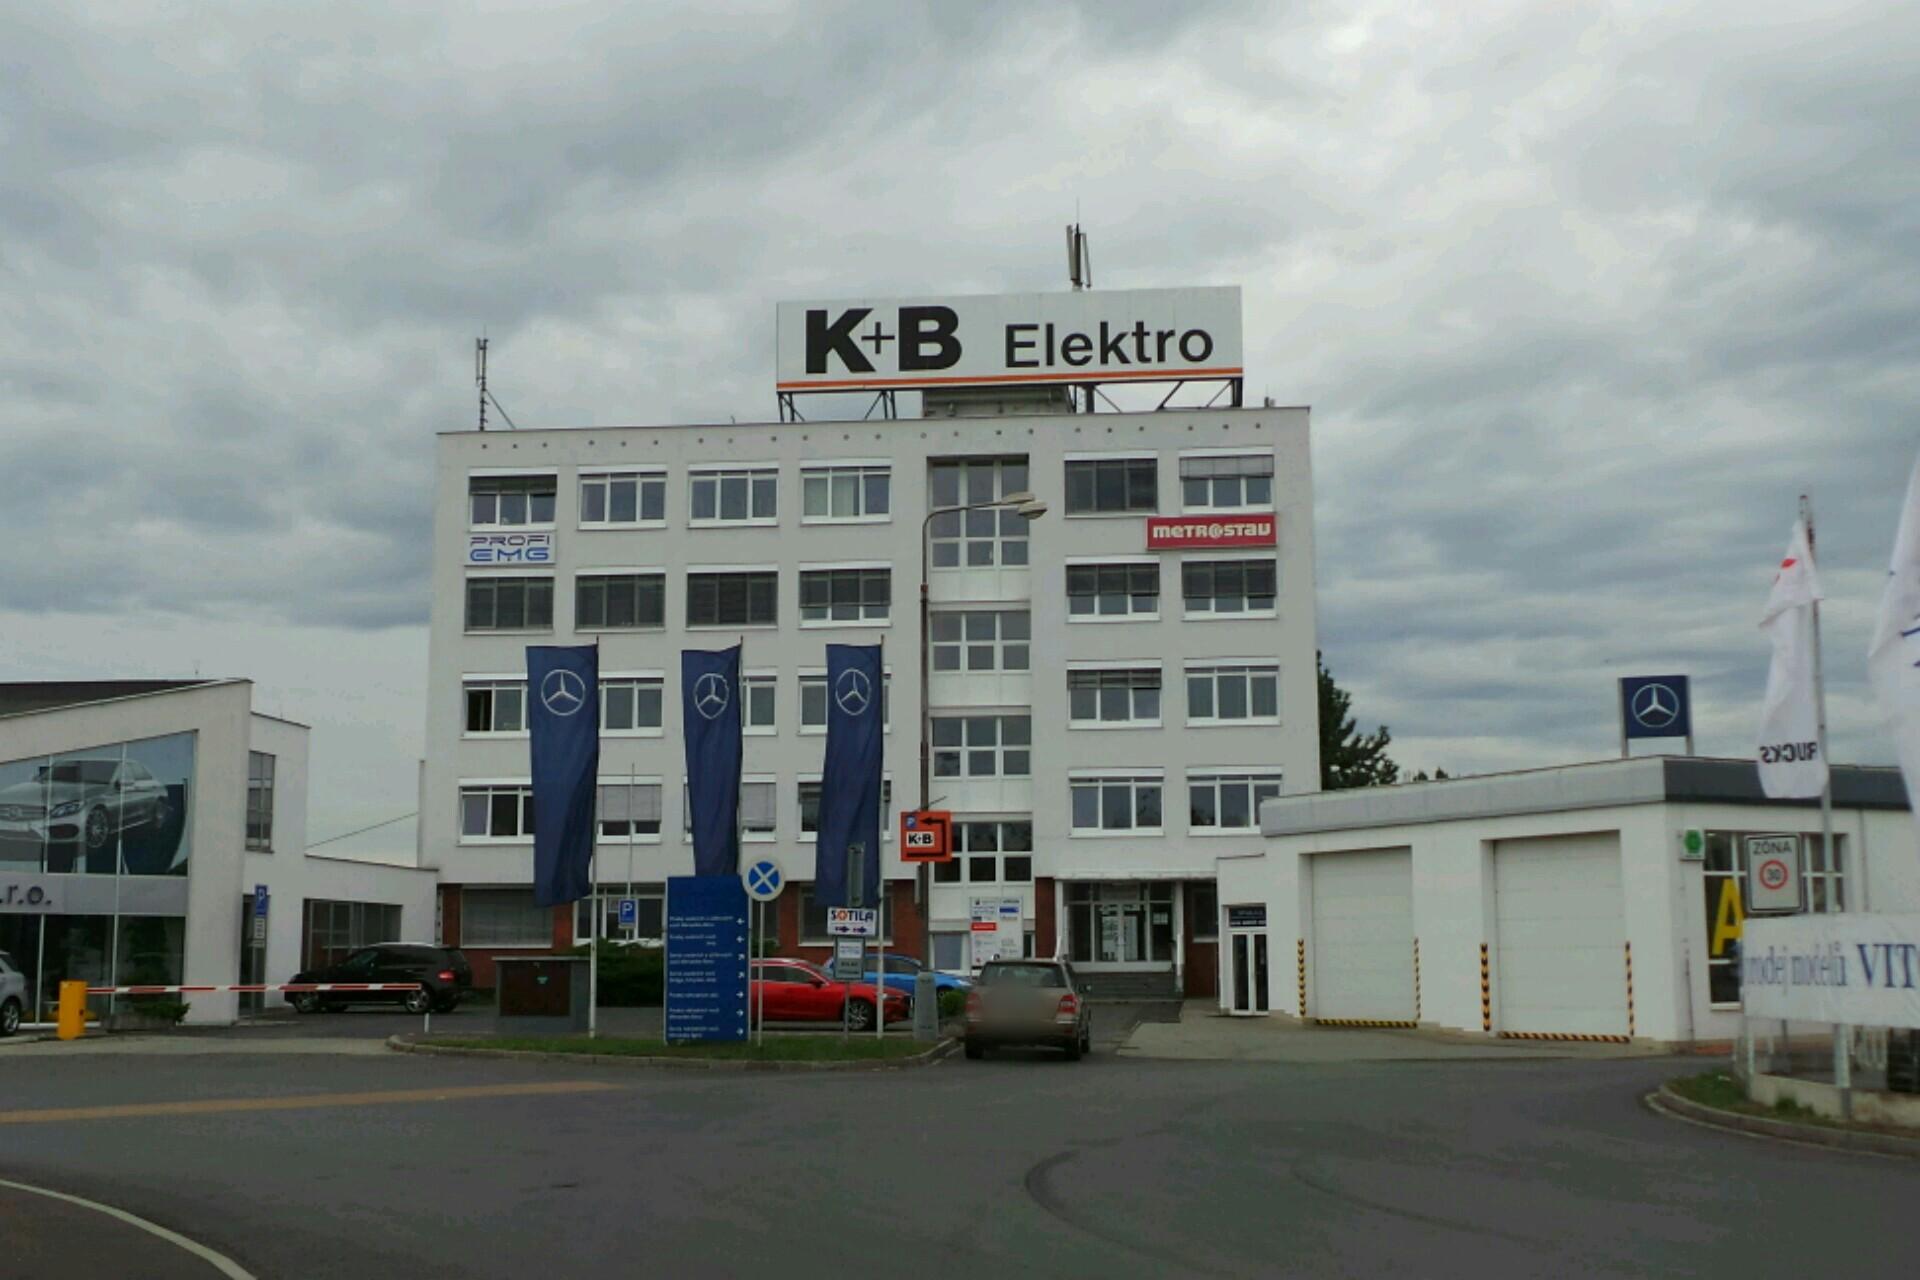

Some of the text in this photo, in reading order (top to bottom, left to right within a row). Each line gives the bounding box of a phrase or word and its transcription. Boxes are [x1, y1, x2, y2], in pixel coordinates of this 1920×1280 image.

[805, 306, 1214, 374] K+B Elektro
[470, 535, 550, 547] PROFI
[470, 547, 550, 561] EMG
[908, 832, 933, 845] K+B
[621, 902, 633, 916] P
[831, 909, 874, 922] SOTILA
[1856, 943, 1920, 988] VIT
